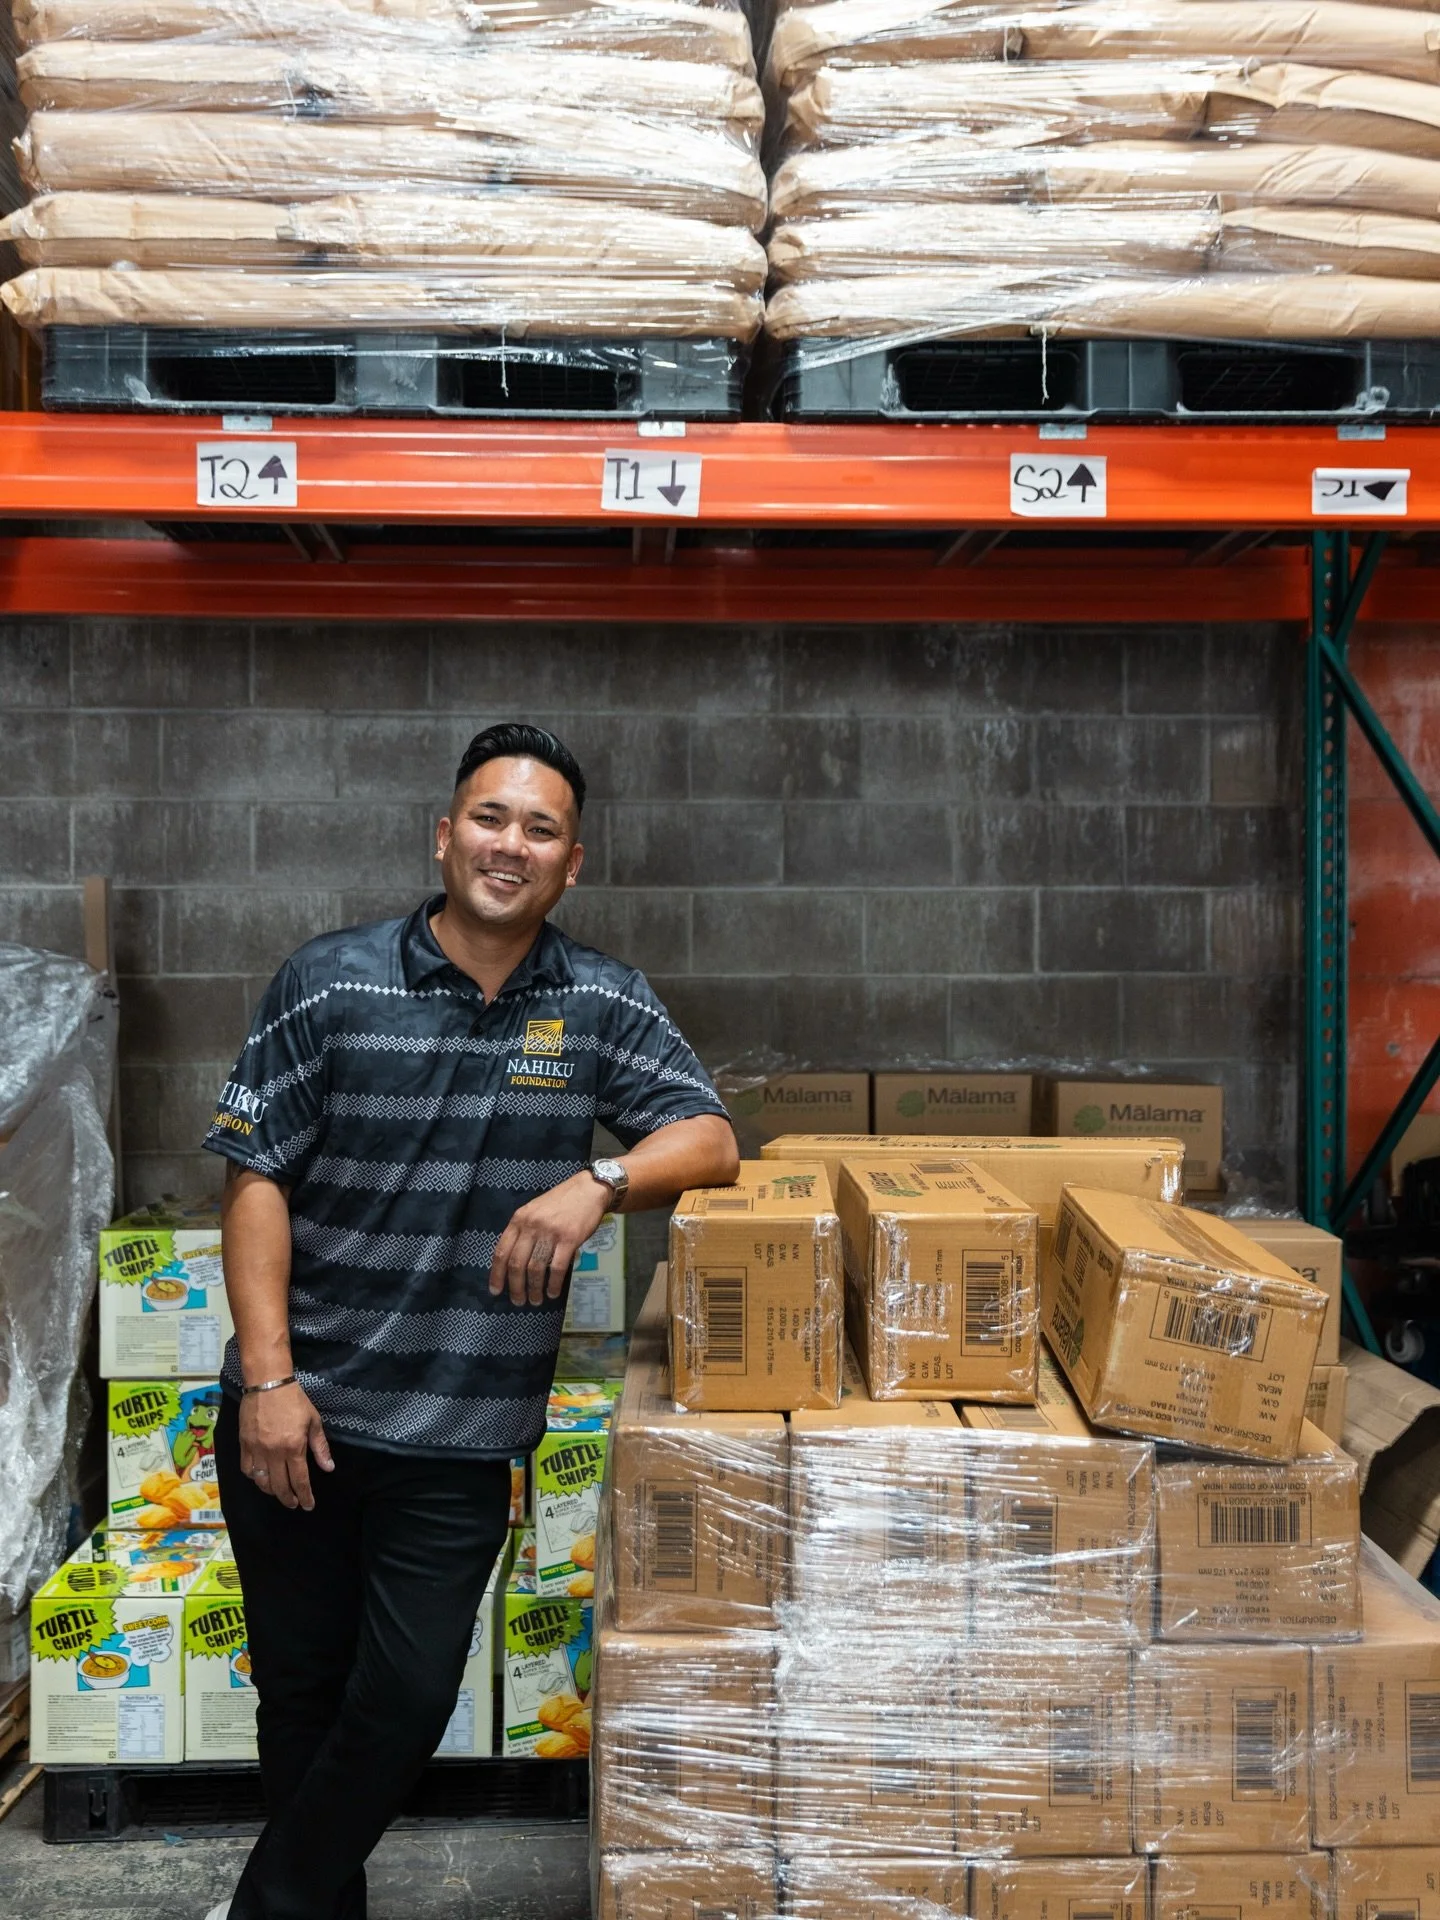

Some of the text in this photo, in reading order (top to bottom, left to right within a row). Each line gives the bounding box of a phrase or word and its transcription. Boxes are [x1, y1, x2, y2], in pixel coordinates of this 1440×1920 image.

[200, 455, 259, 500] T2
[607, 457, 645, 500] T1
[1013, 464, 1068, 503] S2
[506, 1059, 575, 1078] NAHIKU
[510, 1075, 567, 1088] FOUNDATION
[104, 1239, 161, 1267] TURTLE
[754, 1243, 762, 1259] LOT
[936, 1249, 943, 1262] mm
[118, 1257, 156, 1277] CHIPS
[935, 1263, 943, 1276] 175
[1163, 1290, 1267, 1319] 8 5
[945, 1363, 953, 1380] LOT
[1144, 1358, 1283, 1396] MEAS. 175 mm
[1267, 1372, 1285, 1383] LOT
[112, 1391, 169, 1420] TURTLE
[1150, 1400, 1168, 1411] BAG
[1261, 1396, 1280, 1408] G.W.
[128, 1409, 165, 1429] CHIPS
[1155, 1412, 1172, 1421] ECO
[1258, 1410, 1278, 1422] N.W.
[540, 1443, 603, 1475] TURTLE
[556, 1463, 597, 1486] CHIPS
[1078, 1470, 1087, 1497] MEAS.
[1105, 1471, 1114, 1490] N.W.
[1201, 1483, 1224, 1491] INDIA
[545, 1498, 579, 1519] 4 LAYERED
[1202, 1496, 1209, 1505] 5
[1300, 1496, 1306, 1505] 8
[35, 1608, 98, 1640] TURTLE
[188, 1605, 245, 1638] TURTL
[508, 1604, 570, 1636] TURTLE
[1279, 1615, 1337, 1624] DESCRIPTION
[52, 1629, 93, 1651] CHIPS
[205, 1625, 245, 1648] CHIPS
[524, 1625, 565, 1647] CHIPS
[513, 1659, 547, 1679] 4 LAYERED
[1392, 1802, 1401, 1820] LOT
[1249, 1880, 1258, 1899] LOT
[1426, 1872, 1434, 1890] LOT
